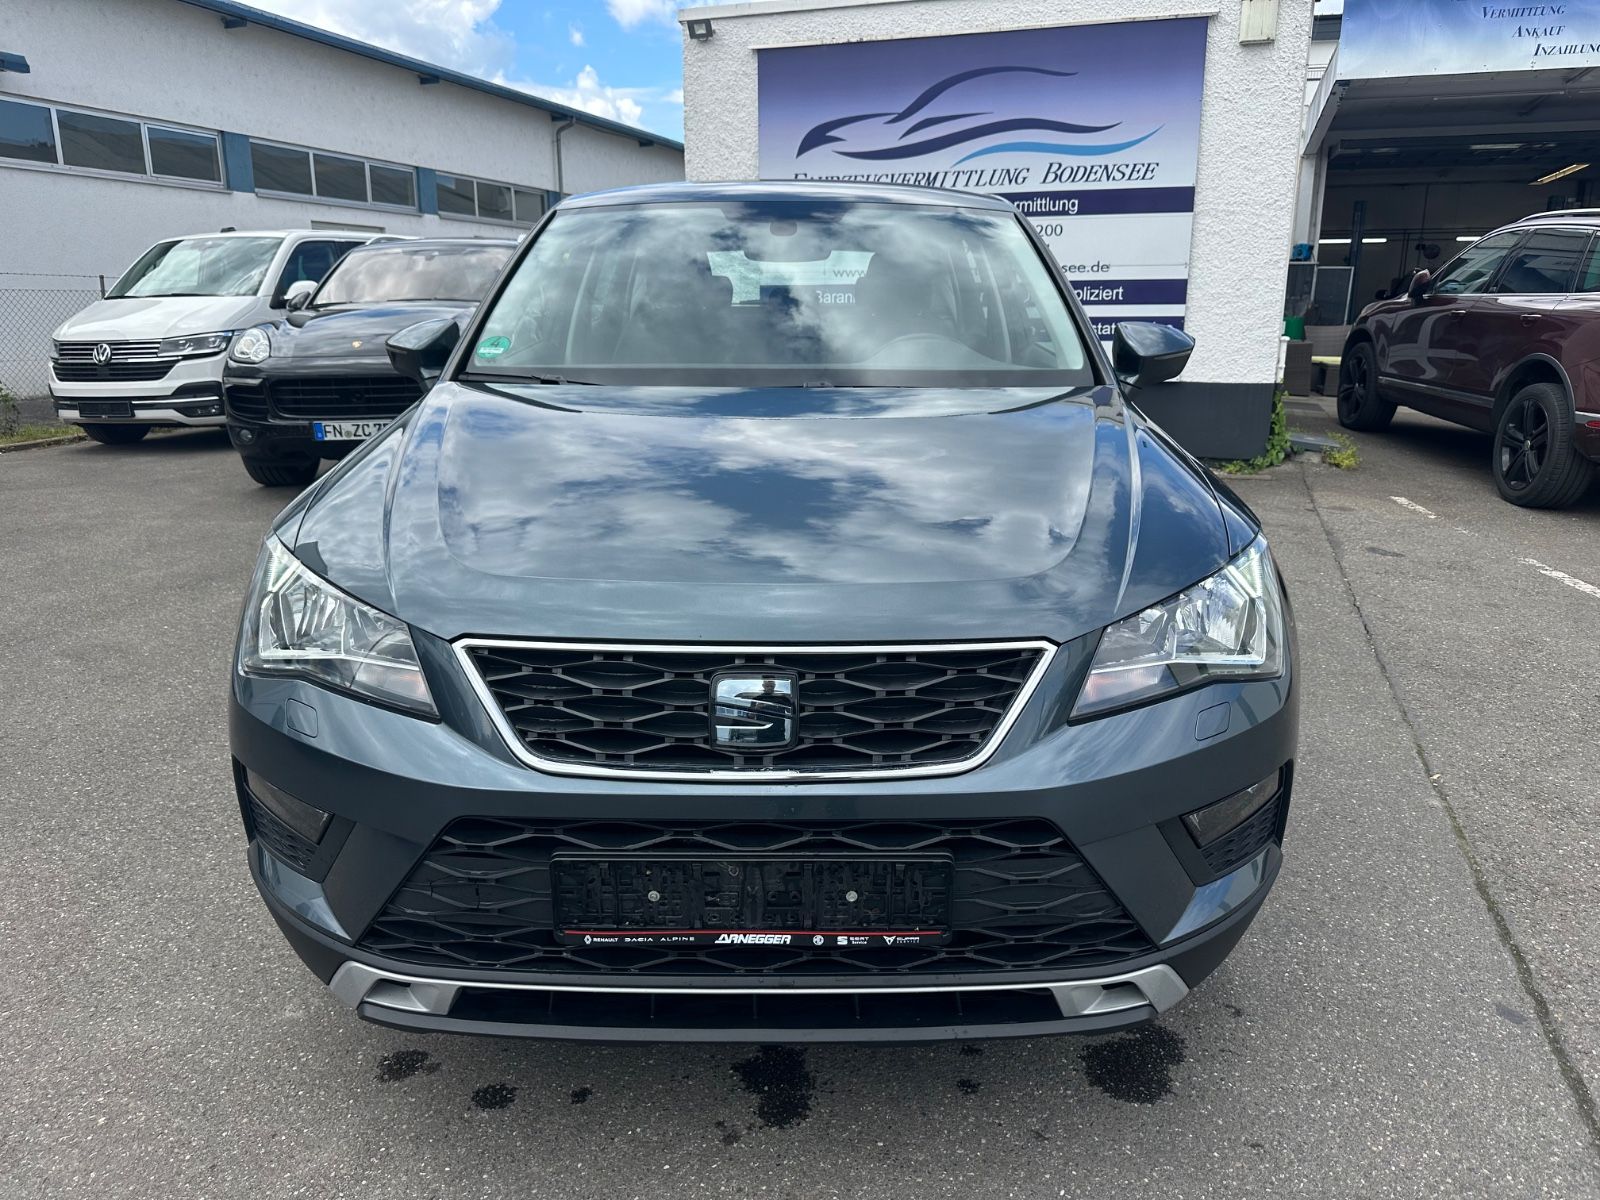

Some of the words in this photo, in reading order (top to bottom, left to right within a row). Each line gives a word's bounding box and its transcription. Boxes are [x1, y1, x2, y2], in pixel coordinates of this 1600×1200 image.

[1482, 5, 1566, 19] VERMITTLUNG
[1512, 25, 1566, 38] ANKAUF
[1040, 162, 1159, 184] BODENSEE
[1014, 196, 1079, 215] rmittlung
[1036, 224, 1063, 237] 200
[1061, 260, 1110, 273] see.de
[714, 933, 792, 945] ARNEGGER
